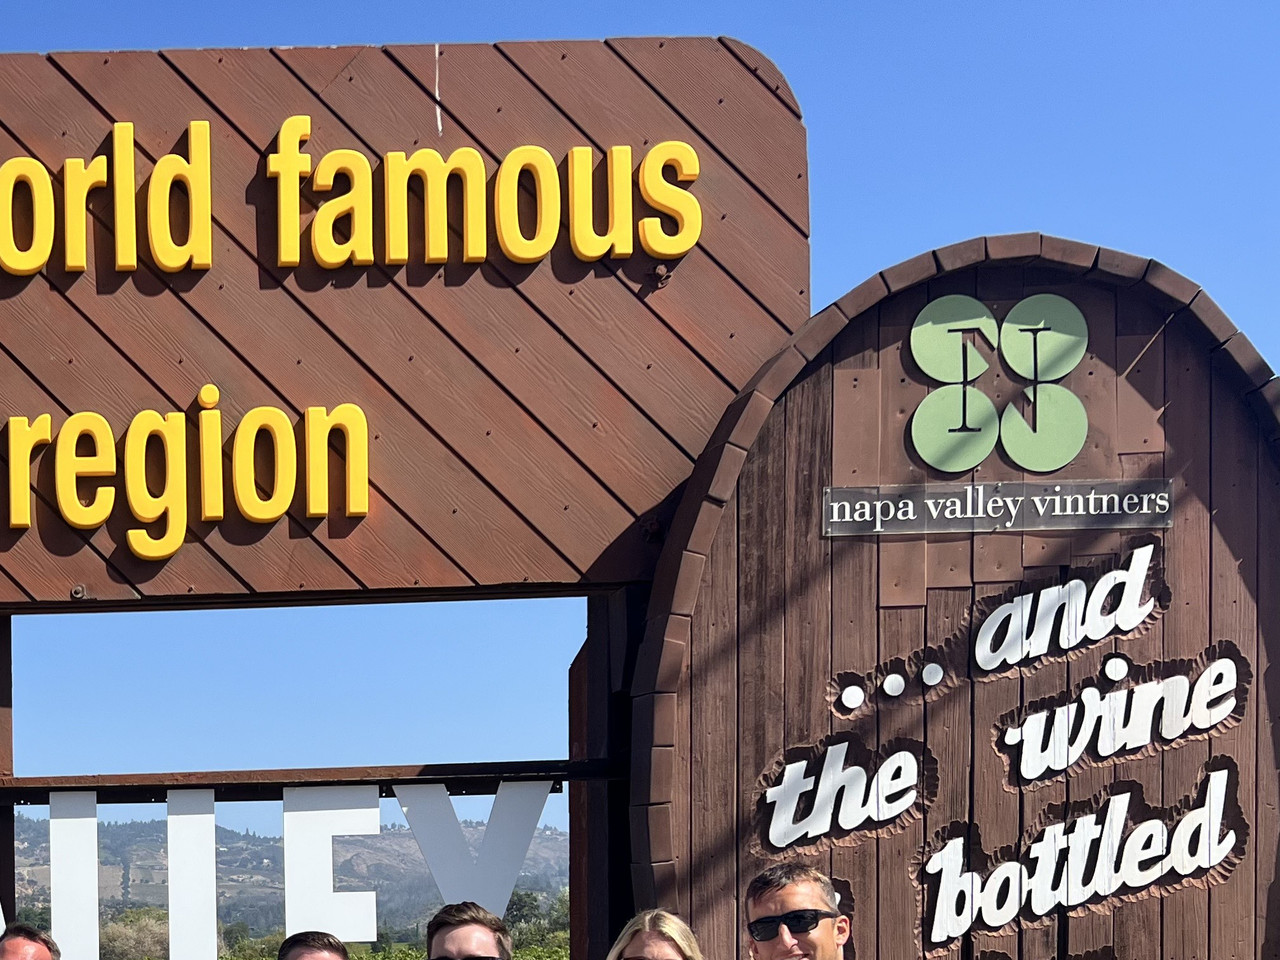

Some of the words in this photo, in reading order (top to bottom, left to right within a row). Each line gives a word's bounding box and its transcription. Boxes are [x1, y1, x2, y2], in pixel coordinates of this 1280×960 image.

[267, 115, 702, 270] famous
[8, 384, 369, 561] region
[829, 498, 917, 532] napa
[923, 485, 1025, 528] valley
[1030, 485, 1170, 516] vintners
[975, 543, 1155, 671] and
[766, 742, 918, 848] the
[1004, 657, 1238, 780] wine
[925, 769, 1242, 943] bottled
